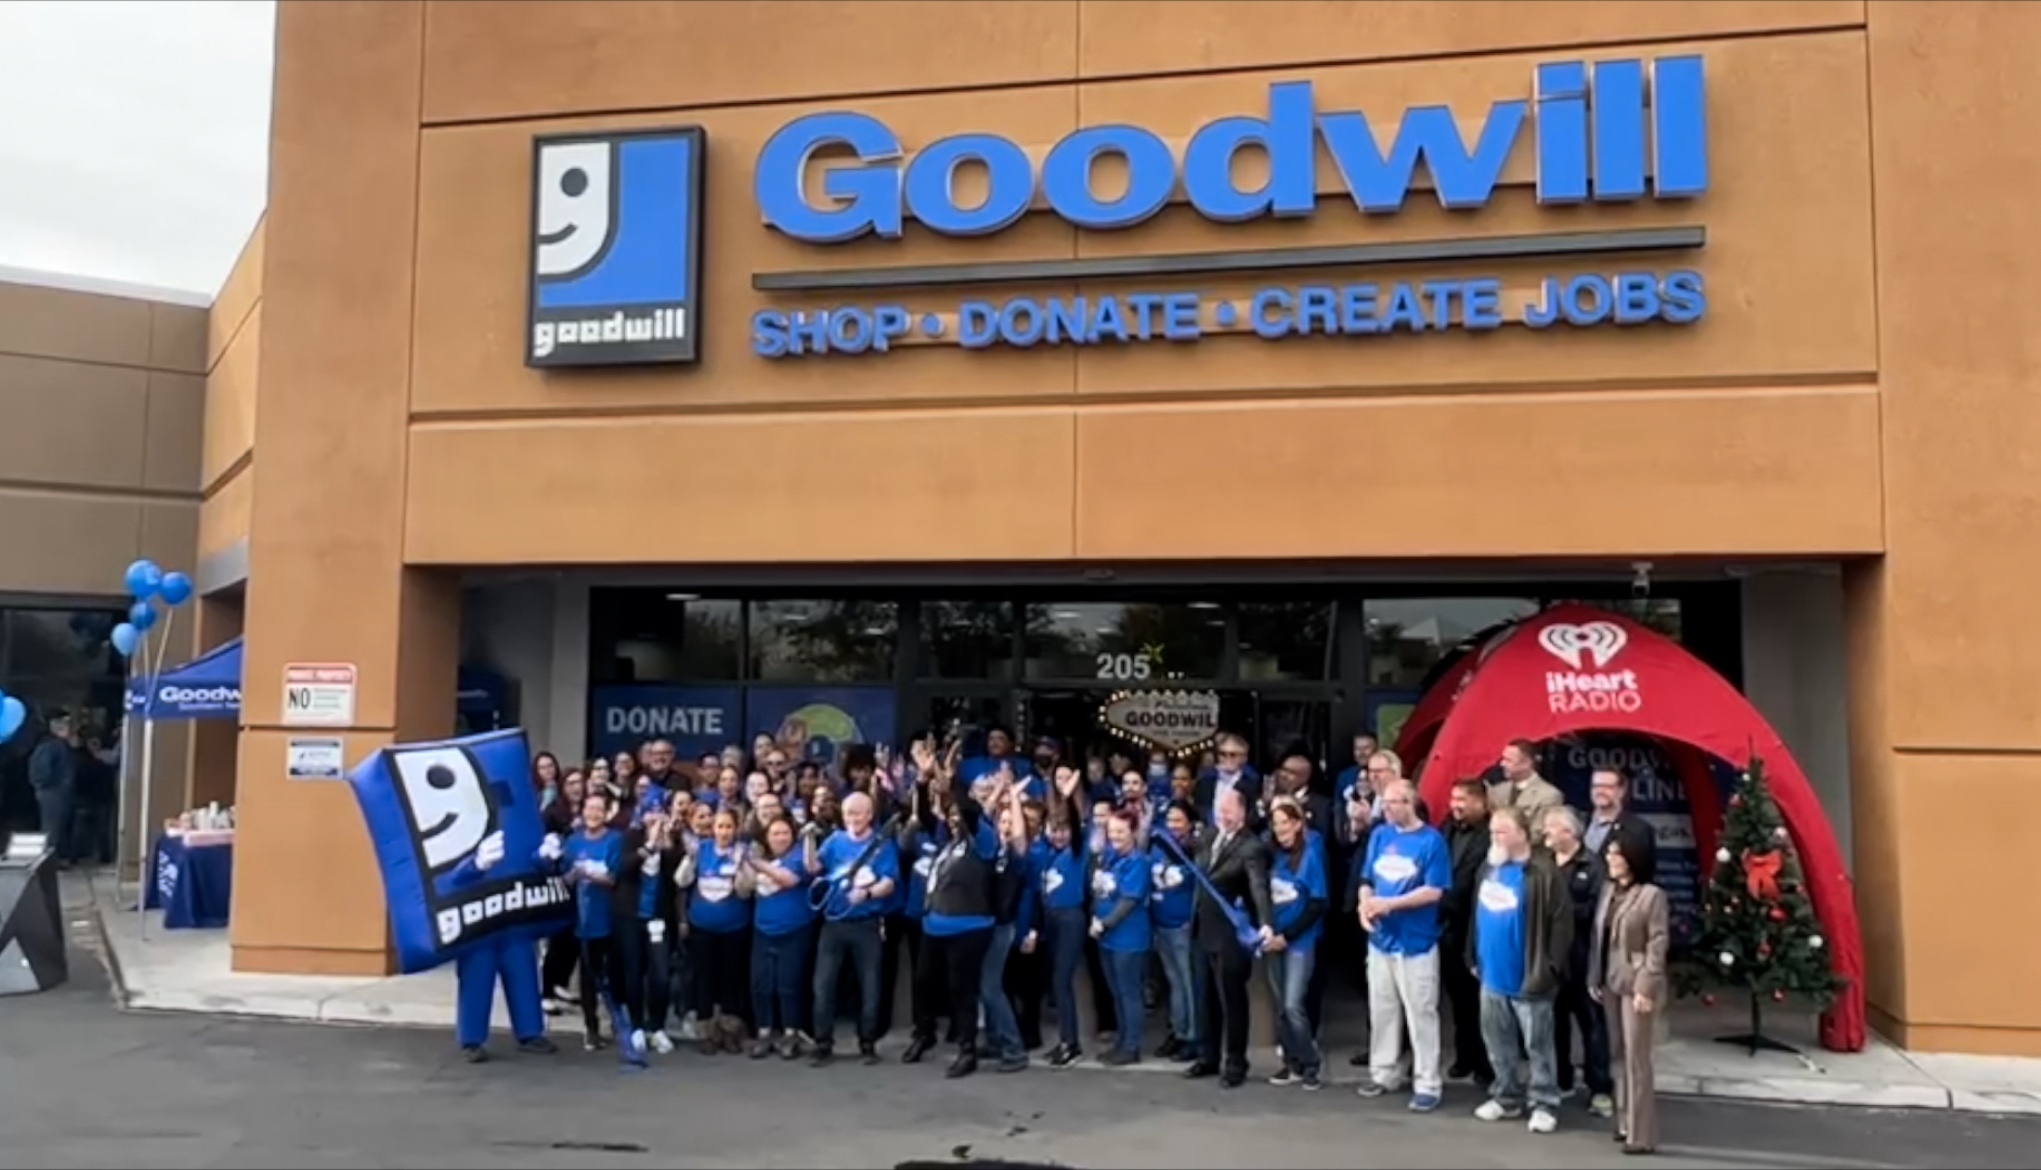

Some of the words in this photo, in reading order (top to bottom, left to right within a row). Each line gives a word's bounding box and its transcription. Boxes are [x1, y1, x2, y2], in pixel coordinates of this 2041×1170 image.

[754, 54, 1708, 245] Goodwill
[752, 309, 909, 358] SHOP
[957, 292, 1200, 349] DONATE
[1249, 275, 1501, 339] CREATE
[1524, 269, 1707, 327] JOBS
[533, 308, 685, 358] goodwill
[1097, 653, 1151, 680] 205
[1546, 669, 1638, 694] iHeart
[288, 687, 311, 710] NO
[1548, 689, 1642, 714] RADIO
[606, 706, 724, 736] DONATE
